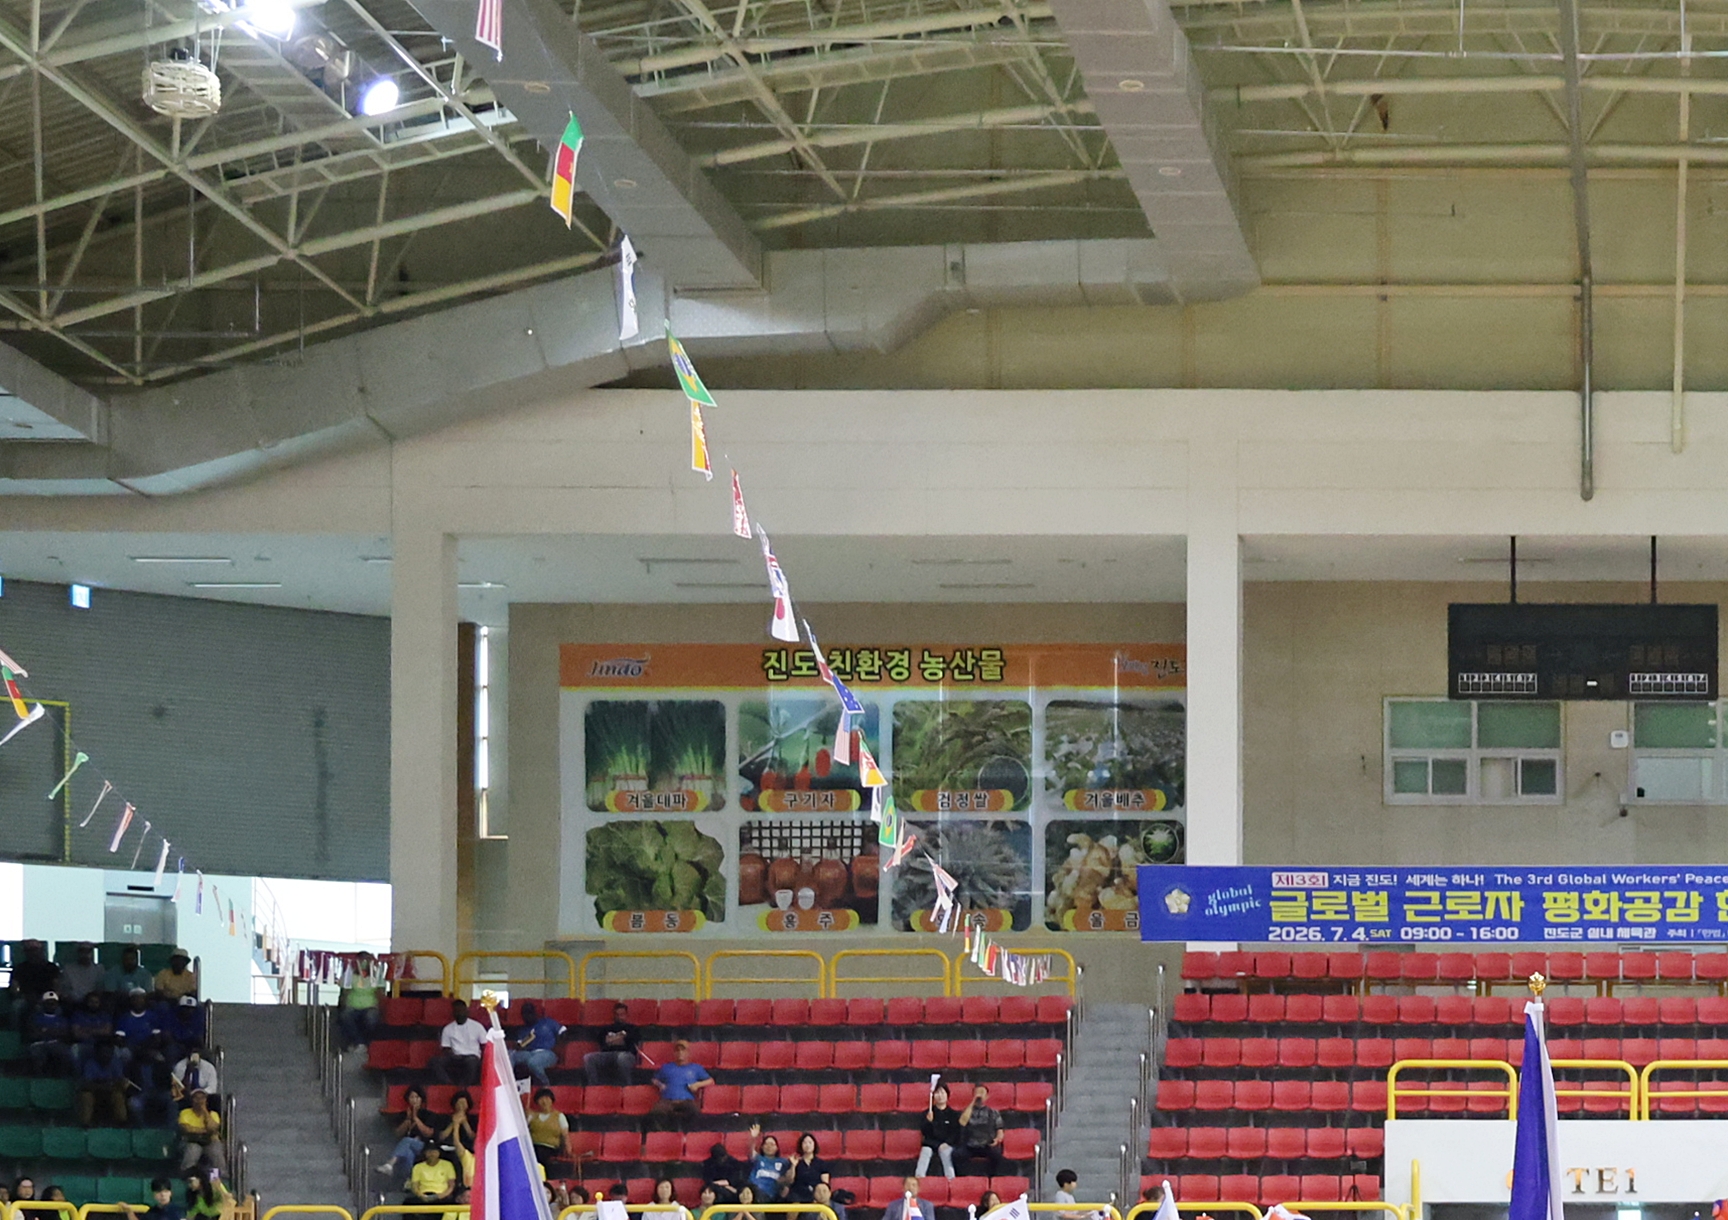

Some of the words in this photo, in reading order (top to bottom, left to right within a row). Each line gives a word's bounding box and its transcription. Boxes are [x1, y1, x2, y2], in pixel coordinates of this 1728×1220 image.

[763, 648, 819, 680] 진도
[827, 648, 911, 681] 친환경
[920, 648, 1006, 682] 농산물
[783, 792, 836, 808] 구기자
[937, 792, 991, 809] 검정쌀
[1084, 792, 1146, 808] 겨울배추
[1274, 873, 1326, 887] 제3회
[1333, 874, 1361, 887] 지금
[1365, 874, 1398, 887] 진도!
[1405, 874, 1448, 887] 세계는
[1452, 874, 1484, 887] 하나!
[1494, 873, 1522, 885] The
[1527, 873, 1553, 885] 3rd
[1558, 873, 1607, 885] Global
[1611, 873, 1680, 885] Workers'
[1208, 884, 1253, 905] global
[1205, 896, 1262, 917] olympic
[1269, 890, 1389, 922] 글로벌
[1403, 890, 1525, 922] 근로자
[1542, 889, 1704, 923] 평화공감
[1268, 926, 1325, 942] 2026.
[1330, 926, 1347, 941] 7.
[1400, 926, 1452, 940] 09:00
[1470, 926, 1519, 940] 16:00
